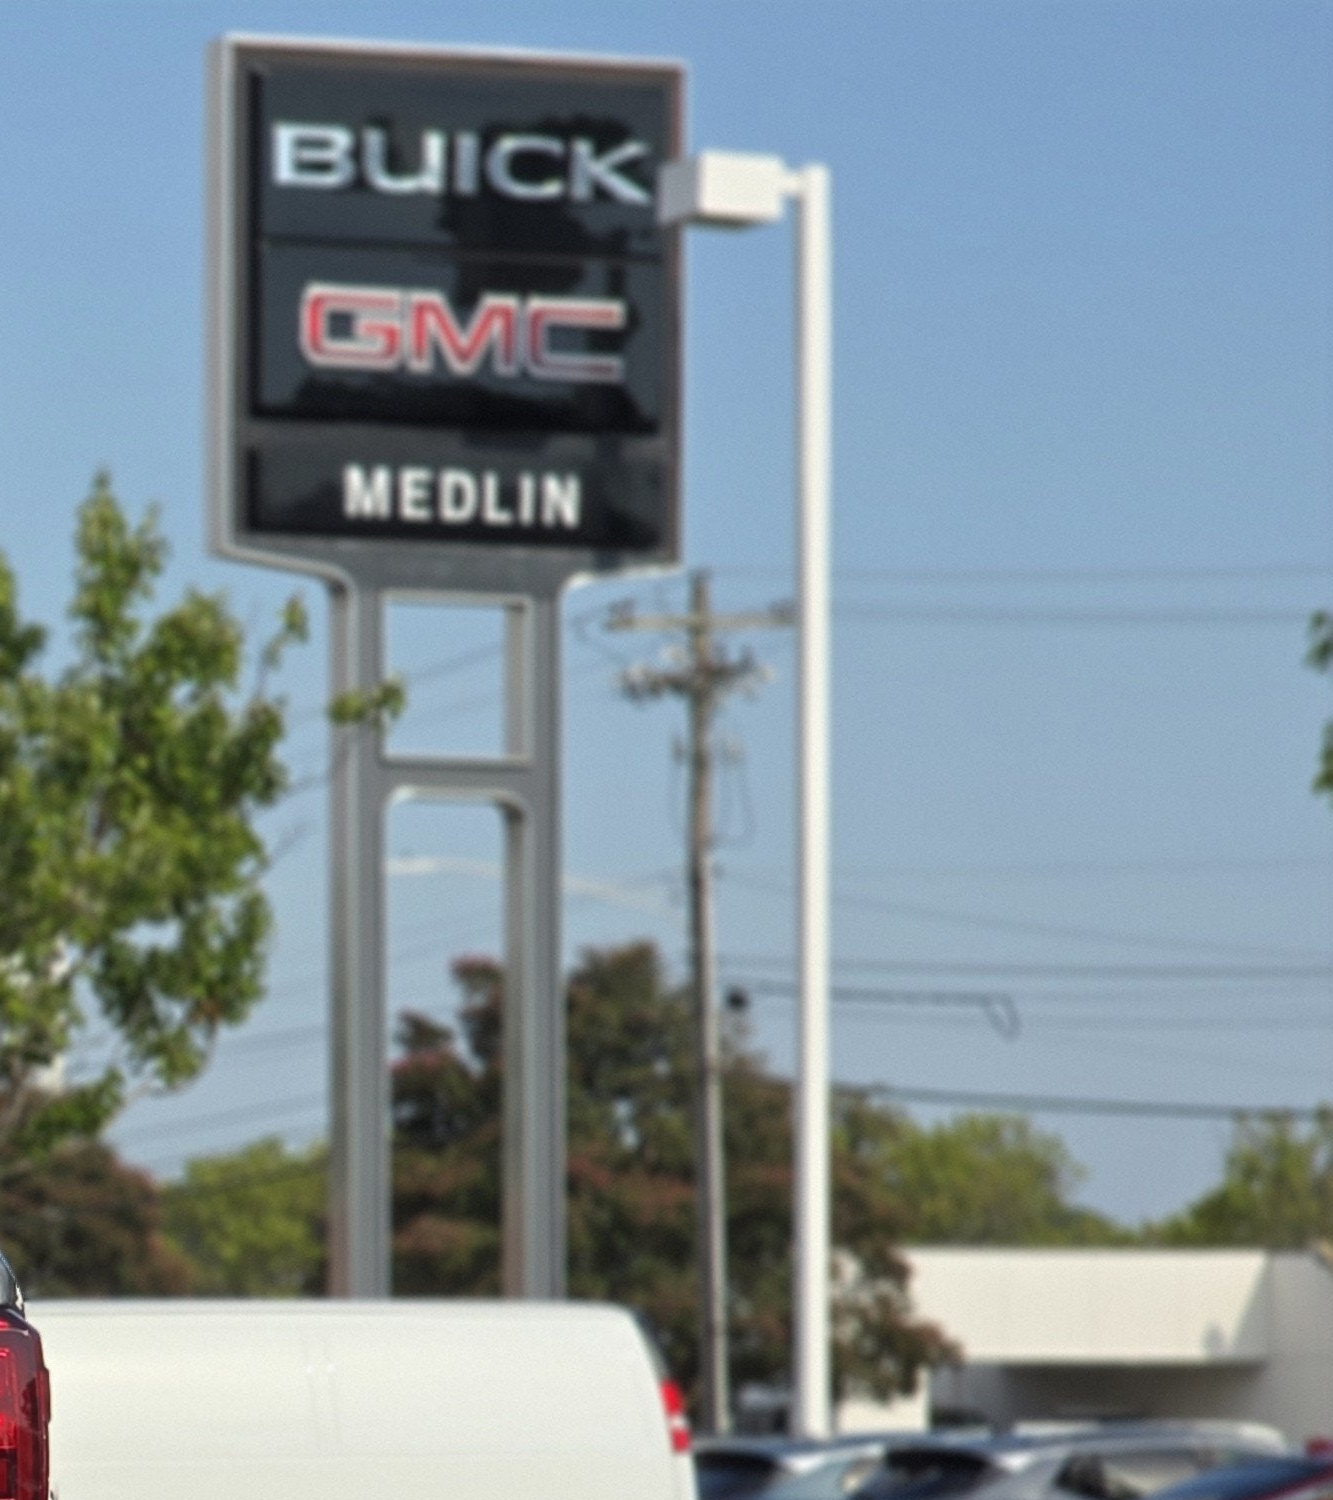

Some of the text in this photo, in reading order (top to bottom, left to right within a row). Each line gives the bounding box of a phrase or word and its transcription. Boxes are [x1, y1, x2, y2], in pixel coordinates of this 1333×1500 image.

[272, 122, 650, 205] BUICK
[300, 282, 625, 381] GMC
[343, 463, 582, 528] MEDLIN
